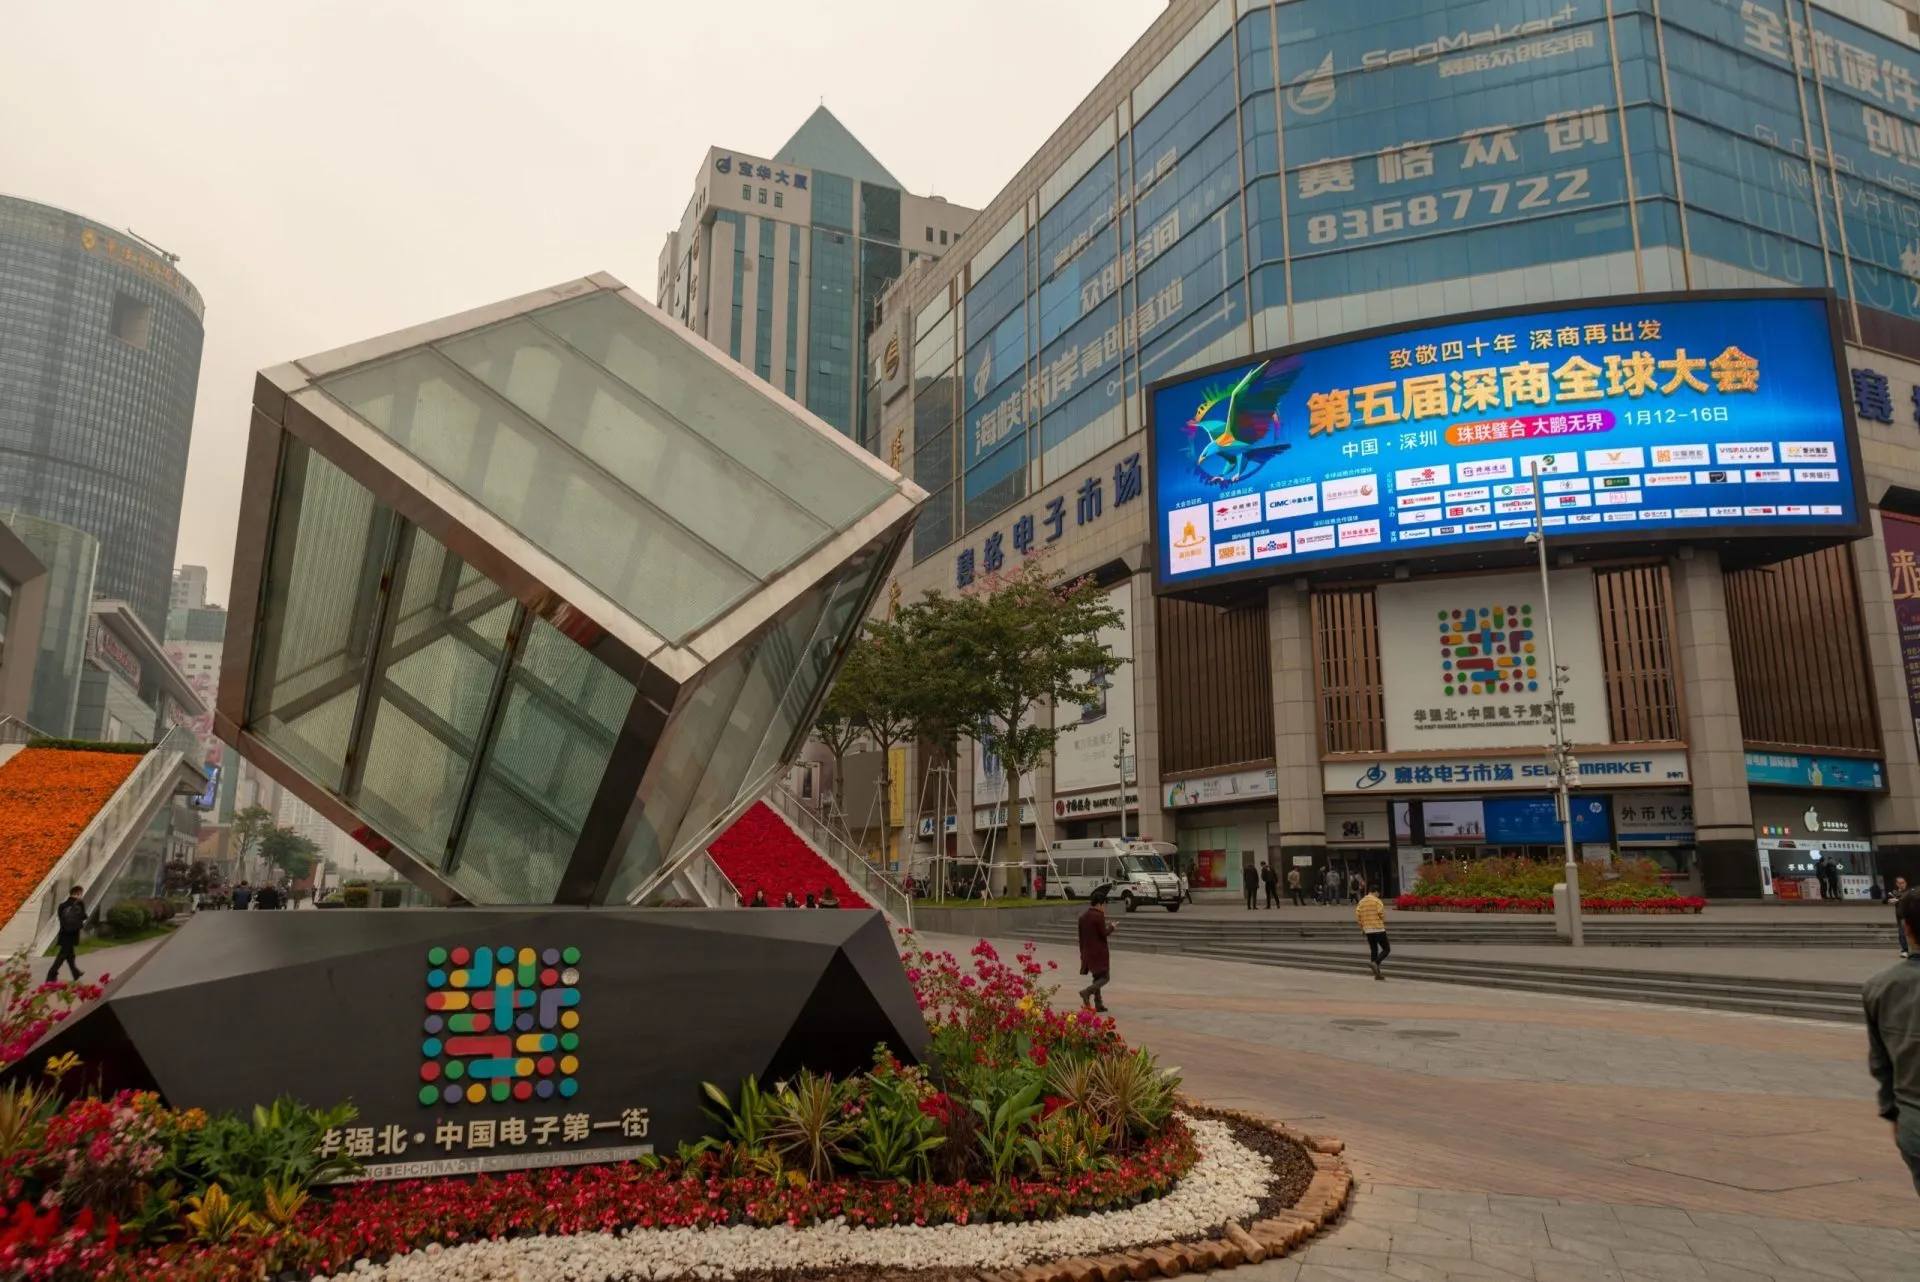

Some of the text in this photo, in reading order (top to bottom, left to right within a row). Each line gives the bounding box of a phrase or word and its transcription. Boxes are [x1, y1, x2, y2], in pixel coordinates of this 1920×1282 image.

[1298, 104, 1609, 198] 赛格众创
[1307, 168, 1591, 245] 83687722
[1389, 320, 1663, 370] 致敬四十年 深商再出发
[1306, 345, 1759, 438] 第五届深商全球大会
[1456, 419, 1527, 443] 珠联璧合
[1532, 413, 1603, 437] 大鹏无界
[1624, 406, 1729, 427] 1月12-16日
[956, 452, 1142, 589] 赛格电子市场
[1269, 500, 1290, 509] CIMC
[1413, 702, 1575, 723] 华强北·中国电子第街
[1394, 763, 1514, 783] 赛格电子市场
[315, 1107, 650, 1158] 华强北·中国电子第一街
